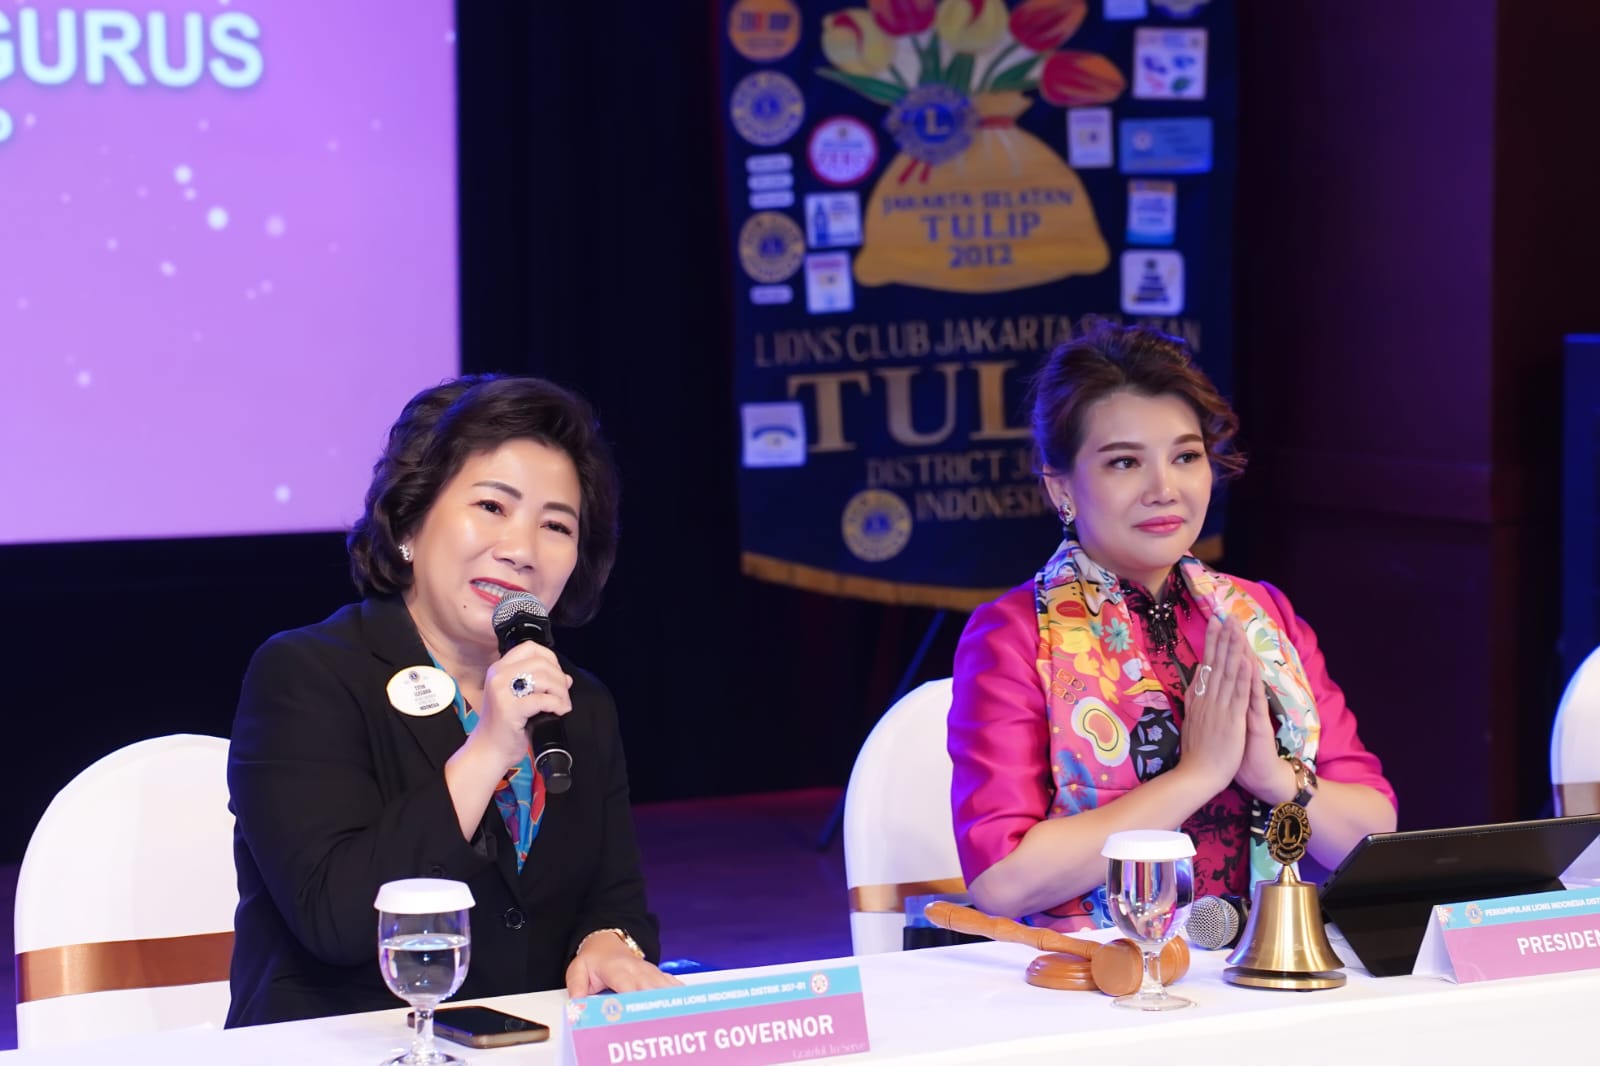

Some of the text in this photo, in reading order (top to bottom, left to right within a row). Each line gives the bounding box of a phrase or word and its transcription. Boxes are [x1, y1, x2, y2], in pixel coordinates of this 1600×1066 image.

[0, 7, 264, 88] URUS
[920, 212, 1041, 242] TULIP
[949, 243, 1014, 269] 2012
[754, 325, 844, 368] LIONS
[845, 319, 932, 363] CLUB
[934, 313, 1074, 357] JAKARTA
[786, 358, 1035, 455] TUL
[866, 449, 1008, 488] DISTRICT
[914, 484, 1048, 522] INDONESI
[1283, 819, 1297, 843] L
[684, 993, 707, 1006] LIONS
[708, 988, 750, 1003] INDONESIA
[608, 1014, 834, 1064] DISTRICT GOVERNOR
